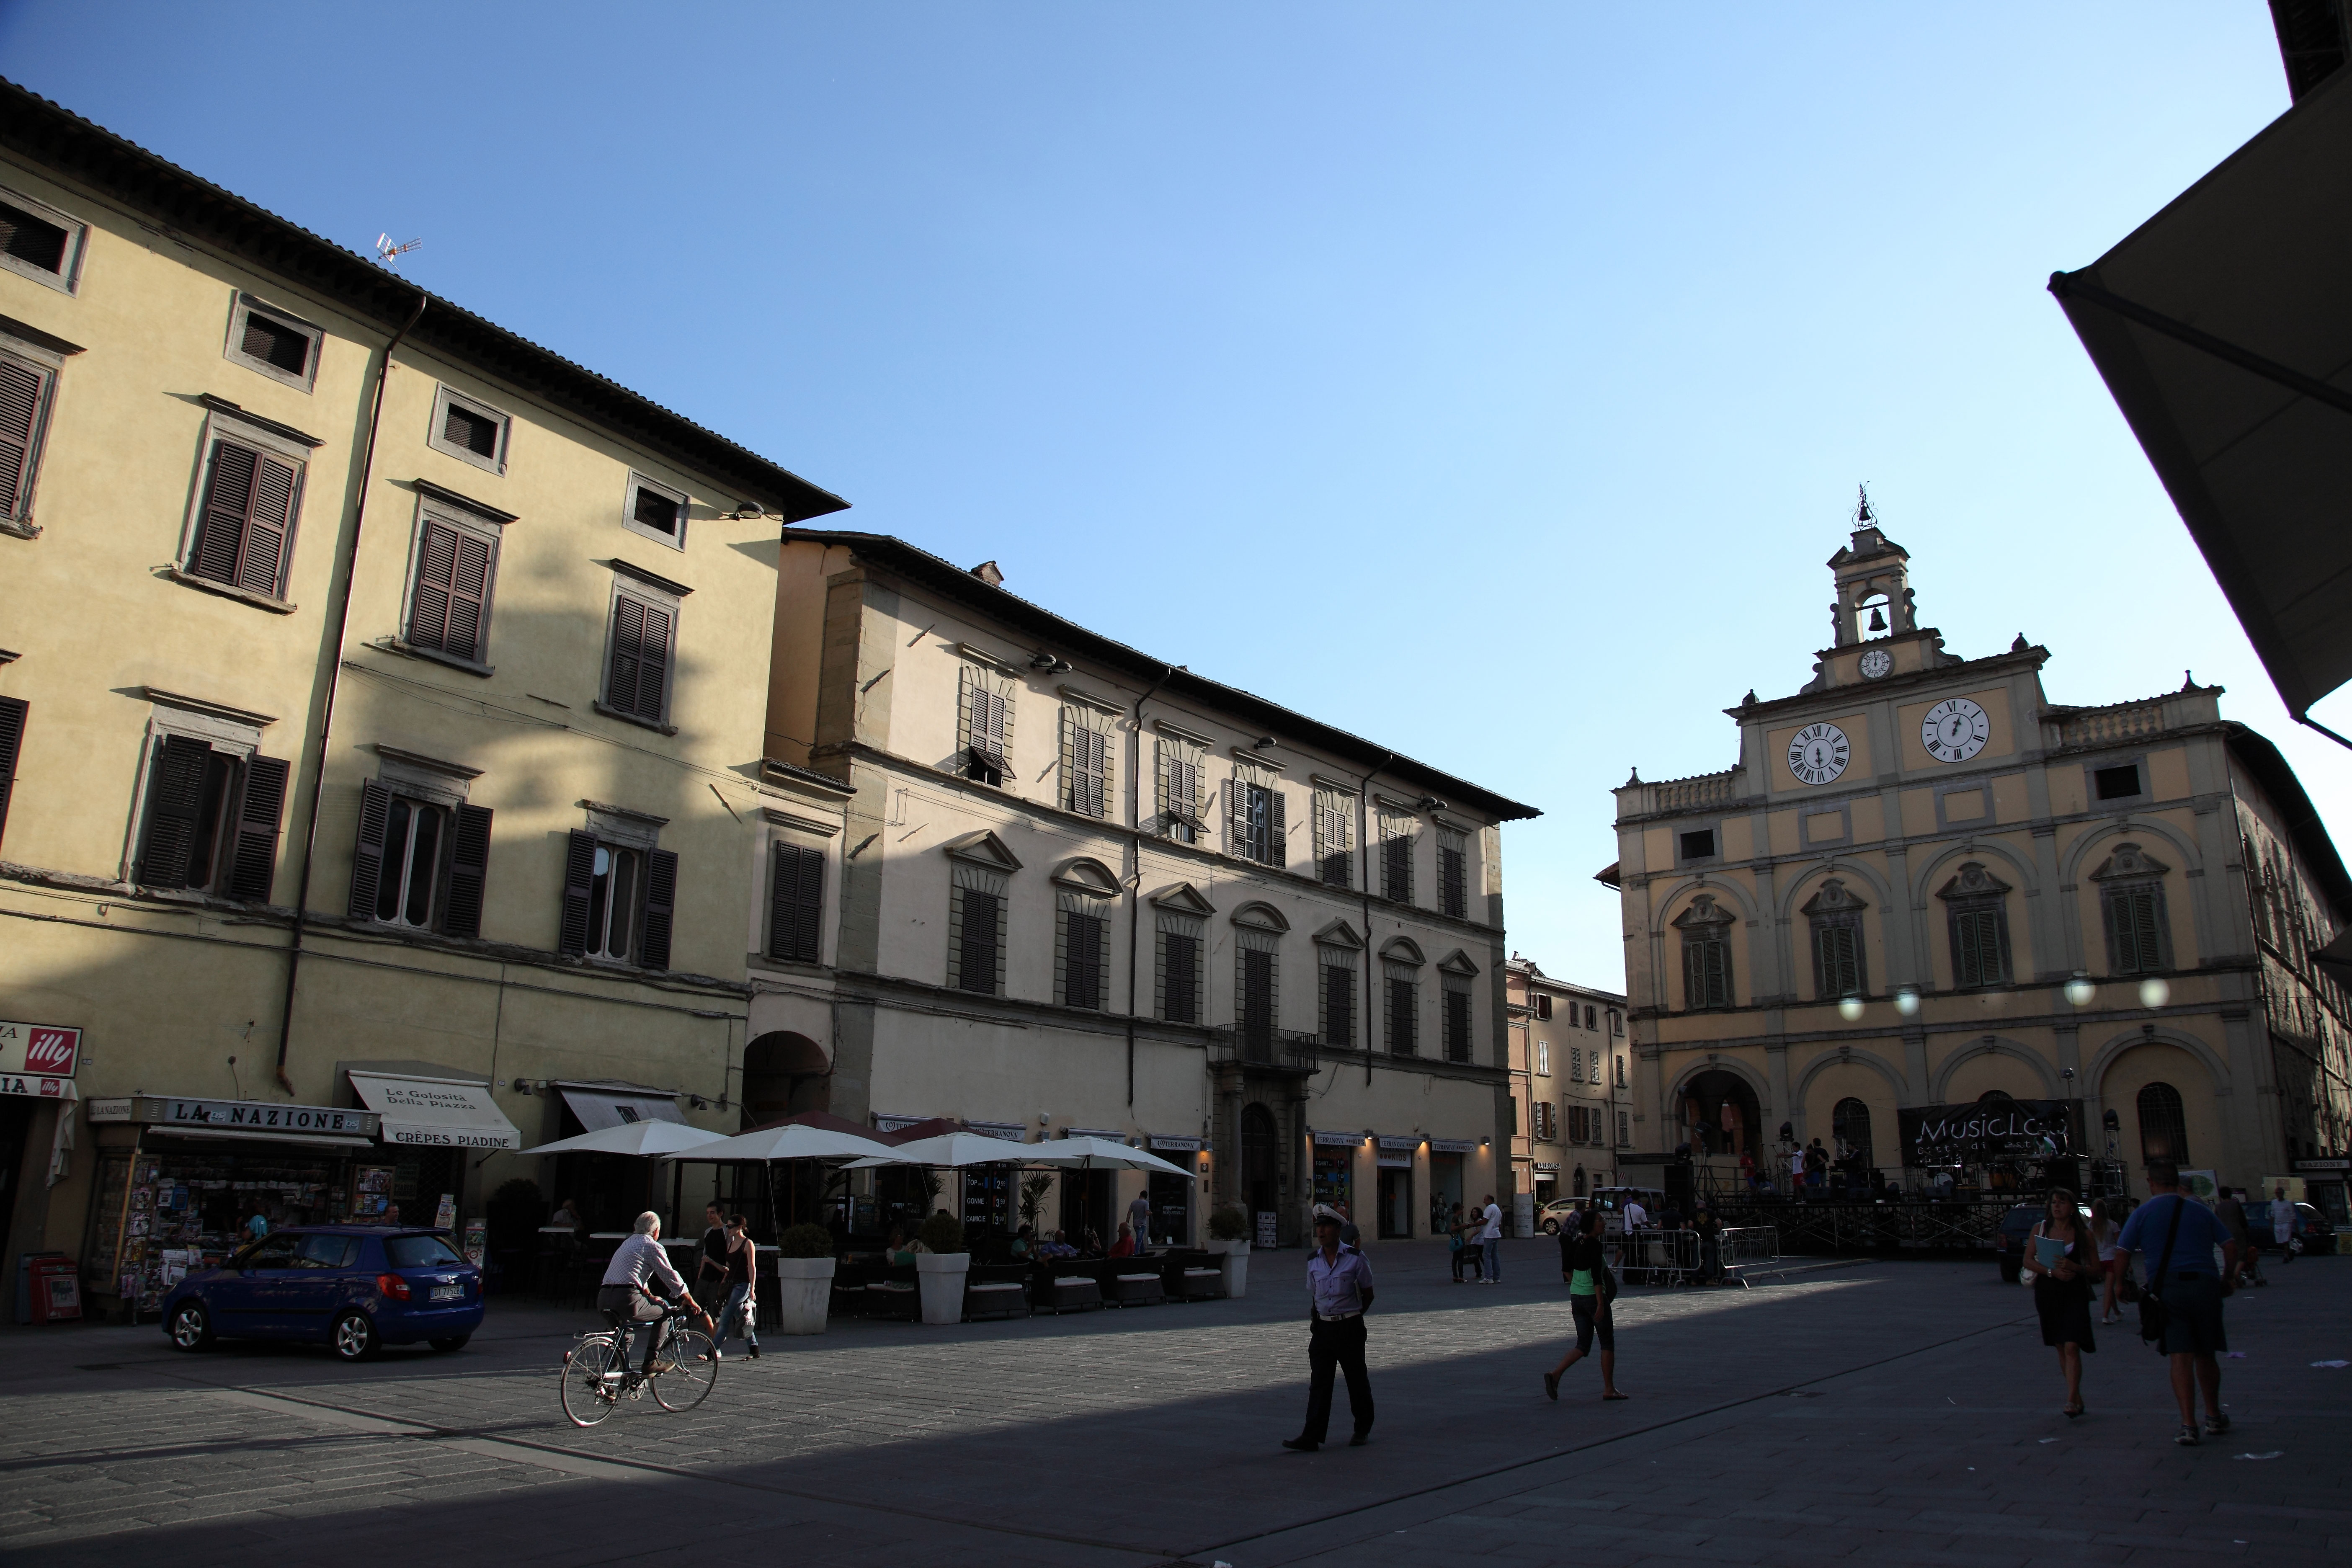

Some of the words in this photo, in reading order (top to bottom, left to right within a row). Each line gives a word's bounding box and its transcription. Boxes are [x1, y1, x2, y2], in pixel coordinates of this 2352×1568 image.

[28, 1034, 72, 1068] illy
[42, 1081, 59, 1093] illy
[388, 1096, 424, 1106] Della
[429, 1100, 477, 1110] Piazza
[409, 1090, 467, 1101] Golosità
[175, 1104, 204, 1120] LA
[231, 1108, 344, 1129] NAZIONE
[396, 1131, 451, 1144] CRÊPES
[458, 1135, 509, 1148] PIADINE
